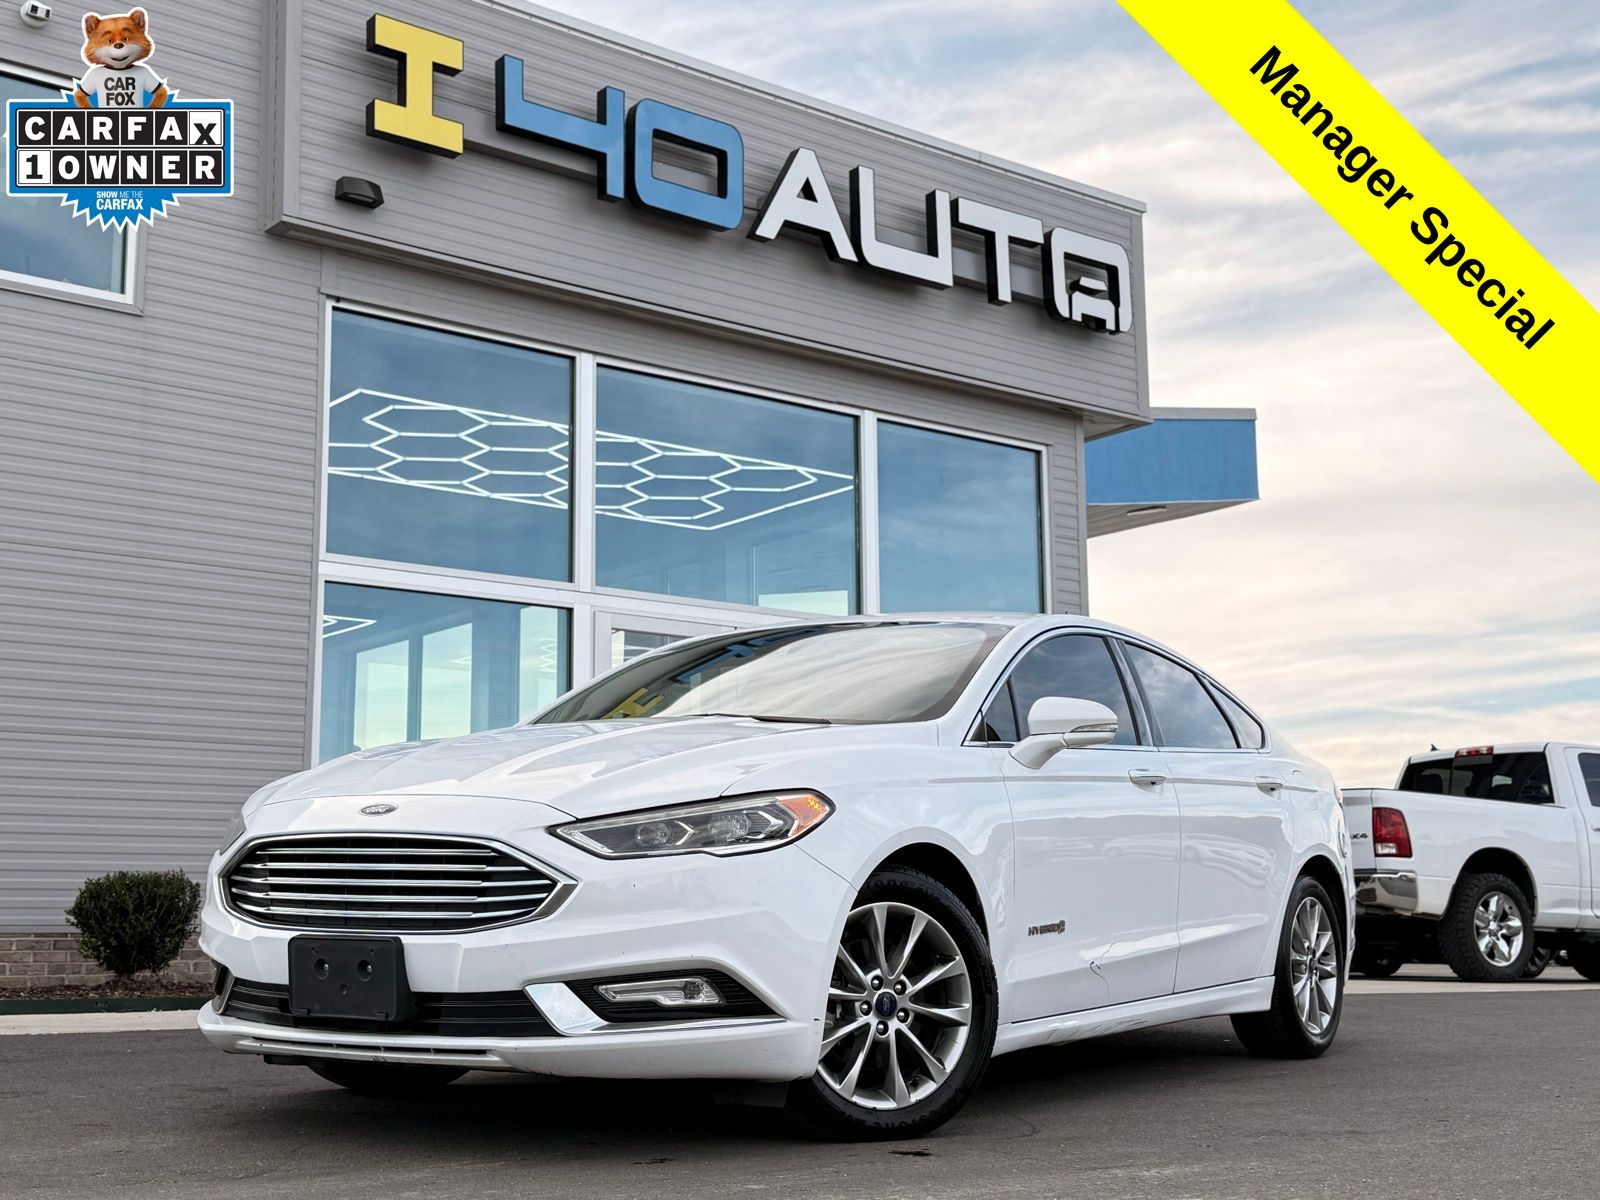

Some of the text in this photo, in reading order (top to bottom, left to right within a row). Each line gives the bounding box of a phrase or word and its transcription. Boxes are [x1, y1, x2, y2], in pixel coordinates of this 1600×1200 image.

[366, 13, 464, 159] I
[748, 146, 1134, 335] AUTO
[1350, 832, 1369, 840] X4
